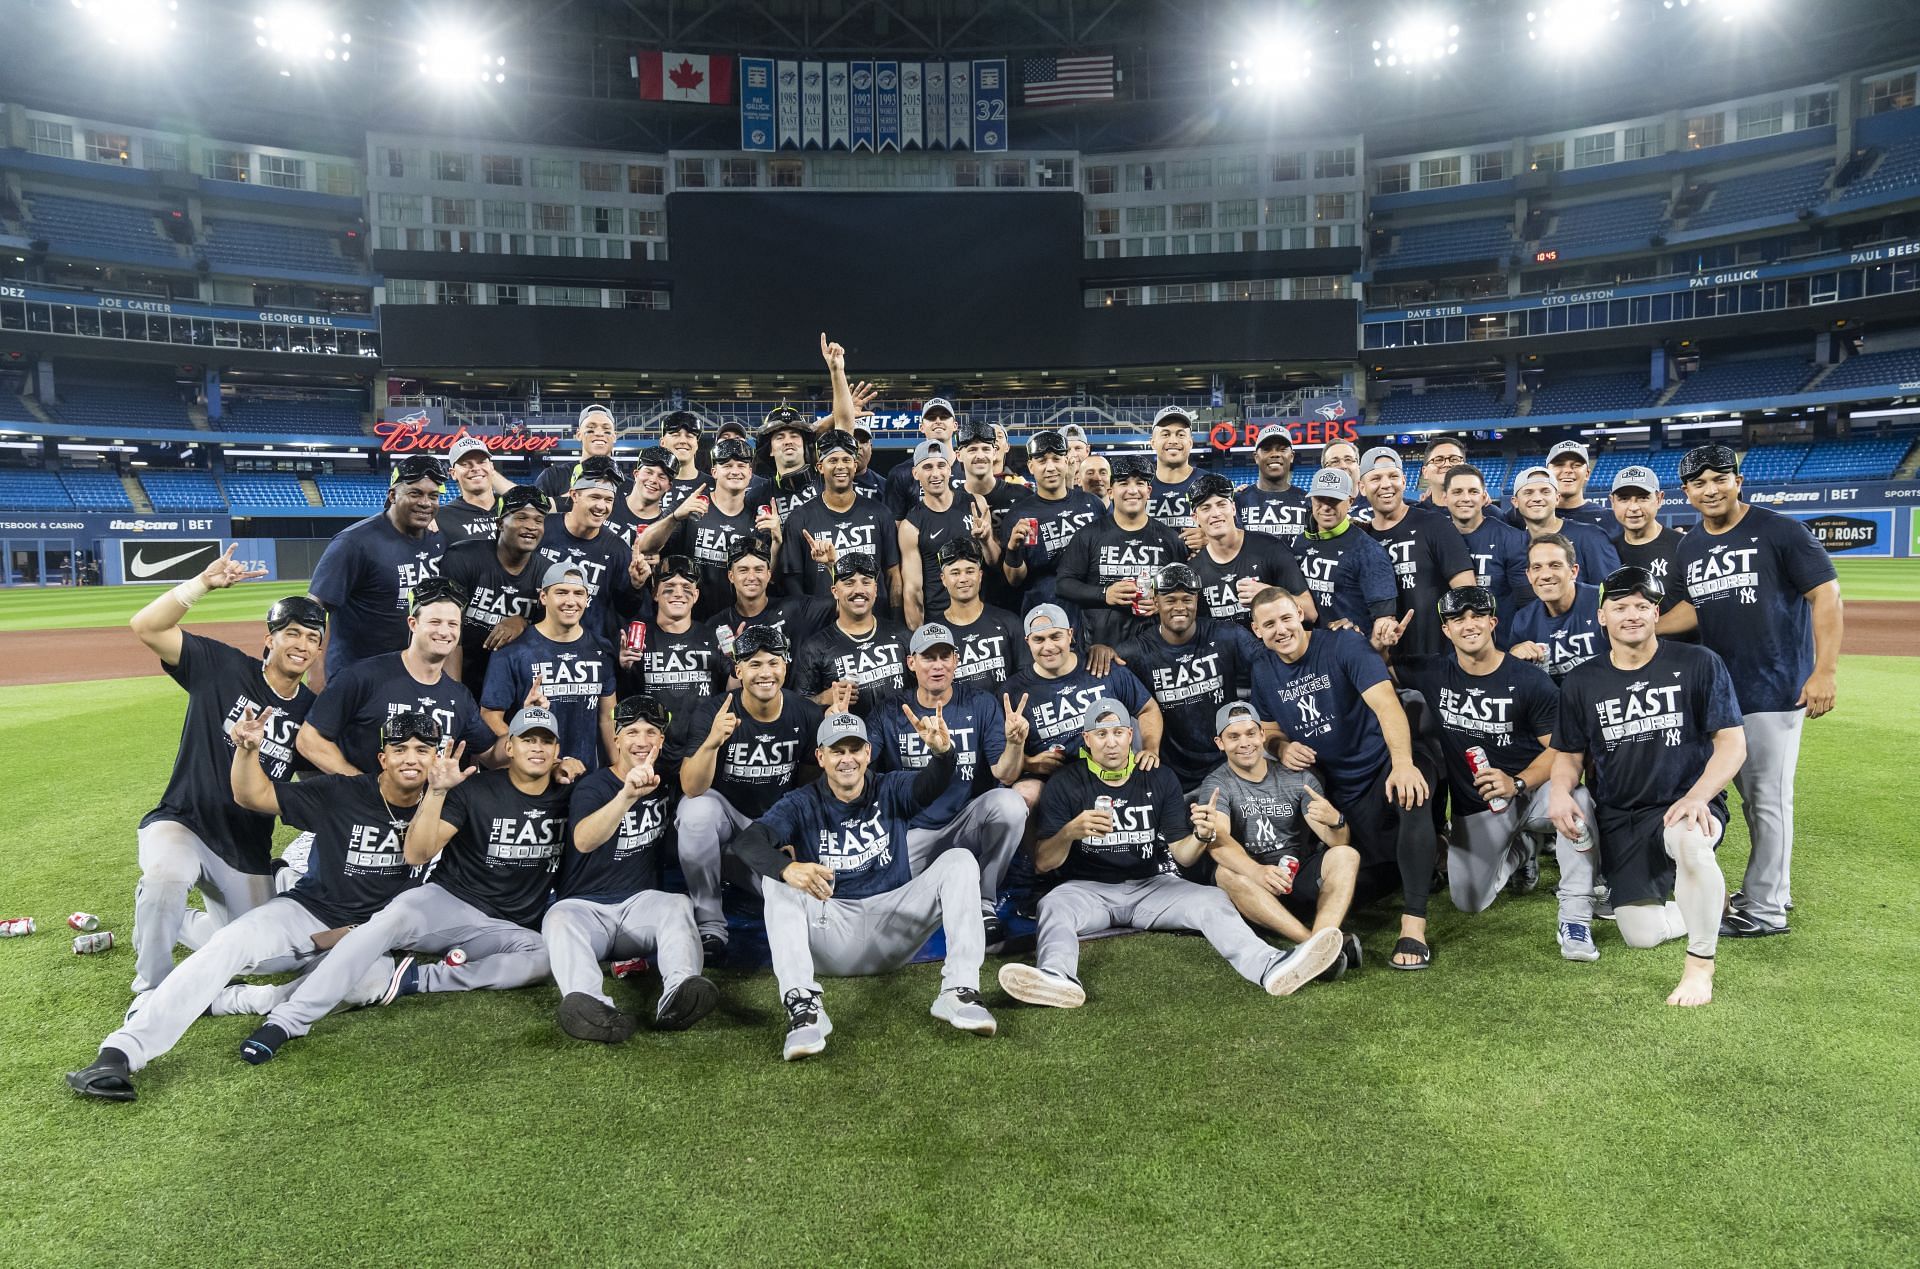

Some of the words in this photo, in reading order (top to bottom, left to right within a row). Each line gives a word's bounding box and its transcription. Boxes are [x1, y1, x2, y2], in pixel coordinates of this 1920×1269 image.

[854, 94, 871, 106] 1992
[880, 94, 896, 106] 1993
[903, 94, 921, 106] 2015
[976, 99, 1006, 120] 32
[830, 117, 847, 126] EAST
[1851, 249, 1882, 263] PAUL
[1689, 276, 1710, 288] PAT
[1714, 269, 1759, 284] GILLICK
[0, 286, 25, 298] DEZ
[1542, 295, 1566, 305] CITO
[1570, 289, 1614, 302] GASTON
[98, 297, 122, 308] JOE
[128, 299, 171, 313] CARTER
[1407, 309, 1431, 319] DAVE
[1435, 306, 1463, 316] STIEB
[259, 312, 303, 324] GEORGE
[309, 315, 333, 326] BELL
[1245, 419, 1359, 447] RGERS
[1750, 491, 1820, 503] theScore
[1831, 488, 1859, 500] BET
[1248, 506, 1307, 524] EAST
[109, 520, 178, 531] theScore
[189, 519, 213, 530] BET
[462, 522, 498, 535] YANK
[1039, 523, 1047, 540] THE
[1046, 511, 1095, 540] EAST
[1835, 527, 1874, 540] ROAST
[695, 528, 705, 546] THE
[1100, 545, 1108, 564] THE
[1107, 545, 1165, 565] EAST
[403, 554, 444, 587] EAS
[1650, 558, 1668, 577] NY
[1691, 548, 1758, 581] EAST
[397, 564, 407, 586] THE
[1402, 573, 1416, 590] NY
[1707, 572, 1752, 593] OURS
[470, 586, 484, 606] THE
[478, 587, 538, 619] EAST
[1208, 585, 1239, 607] EA
[1320, 592, 1333, 607] NY
[1740, 586, 1758, 604] NY
[643, 652, 651, 671] THE
[651, 650, 712, 672] EAST
[834, 658, 843, 677] THE
[842, 643, 900, 676] EAST
[965, 658, 1005, 674] OURS
[540, 661, 603, 684] EAST
[650, 673, 665, 683] IS
[669, 672, 710, 683] OURS
[863, 663, 903, 680] OURS
[995, 668, 1007, 682] NY
[1152, 668, 1162, 691] THE
[1160, 652, 1219, 690] EAST
[556, 683, 599, 695] OURS
[699, 682, 710, 696] NY
[893, 674, 904, 690] NY
[1162, 689, 1175, 702] IS
[1180, 679, 1222, 697] OURS
[1277, 674, 1331, 703] YANKEES
[1286, 679, 1299, 688] NEW
[587, 695, 599, 710] NY
[1213, 688, 1225, 704] NY
[1440, 687, 1448, 708] THE
[1447, 688, 1513, 723] EAST
[1604, 684, 1682, 725] EAST
[228, 694, 249, 719] THE
[1296, 694, 1321, 723] NY
[1595, 701, 1608, 727] THE
[1032, 707, 1042, 729] THE
[1294, 713, 1336, 731] BASEBALL
[1610, 725, 1627, 739] IS
[1629, 714, 1678, 734] OURS
[1047, 723, 1060, 737] IS
[1665, 727, 1681, 747] NY
[899, 733, 907, 755] THE
[1496, 734, 1512, 747] NY
[734, 739, 799, 766] EAST
[909, 756, 924, 768] IS
[270, 760, 287, 779] NY
[729, 765, 745, 776] IS
[749, 763, 794, 777] OURS
[960, 765, 974, 781] NY
[778, 773, 791, 786] NY
[625, 797, 670, 836] EAST
[1110, 804, 1153, 832] AST
[349, 824, 363, 849] THE
[489, 818, 502, 843] THE
[499, 818, 568, 845] EAST
[828, 809, 886, 855] EAST
[1107, 830, 1153, 845] OURS
[1256, 815, 1277, 841] NY
[496, 845, 512, 858] IS
[517, 843, 563, 858] OURS
[819, 829, 828, 854] THE
[1141, 843, 1153, 859] NY
[356, 852, 373, 865] IS
[546, 858, 560, 873] NY
[879, 848, 893, 867] NY
